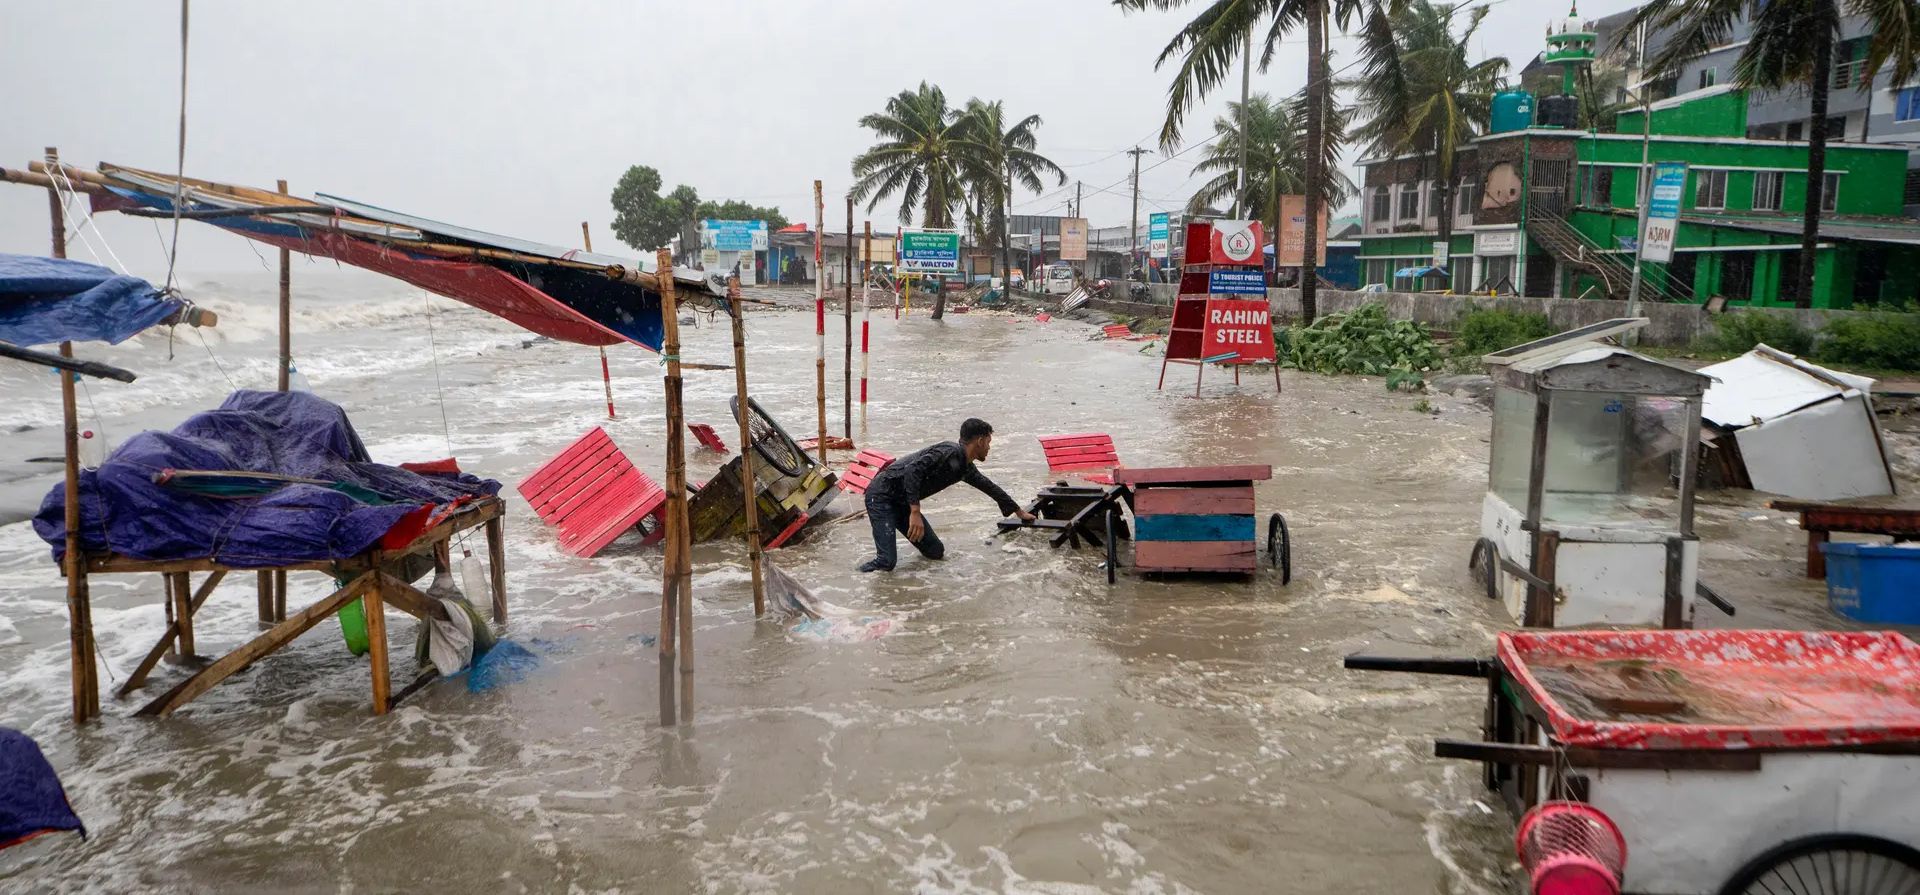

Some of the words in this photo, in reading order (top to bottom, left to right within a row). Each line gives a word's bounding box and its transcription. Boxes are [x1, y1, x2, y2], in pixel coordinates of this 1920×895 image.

[1236, 239, 1242, 247] R
[1221, 273, 1243, 281] TOURIST
[1244, 274, 1263, 282] POLICE
[1211, 309, 1268, 325] RAHIM
[1216, 328, 1262, 344] STEEL
